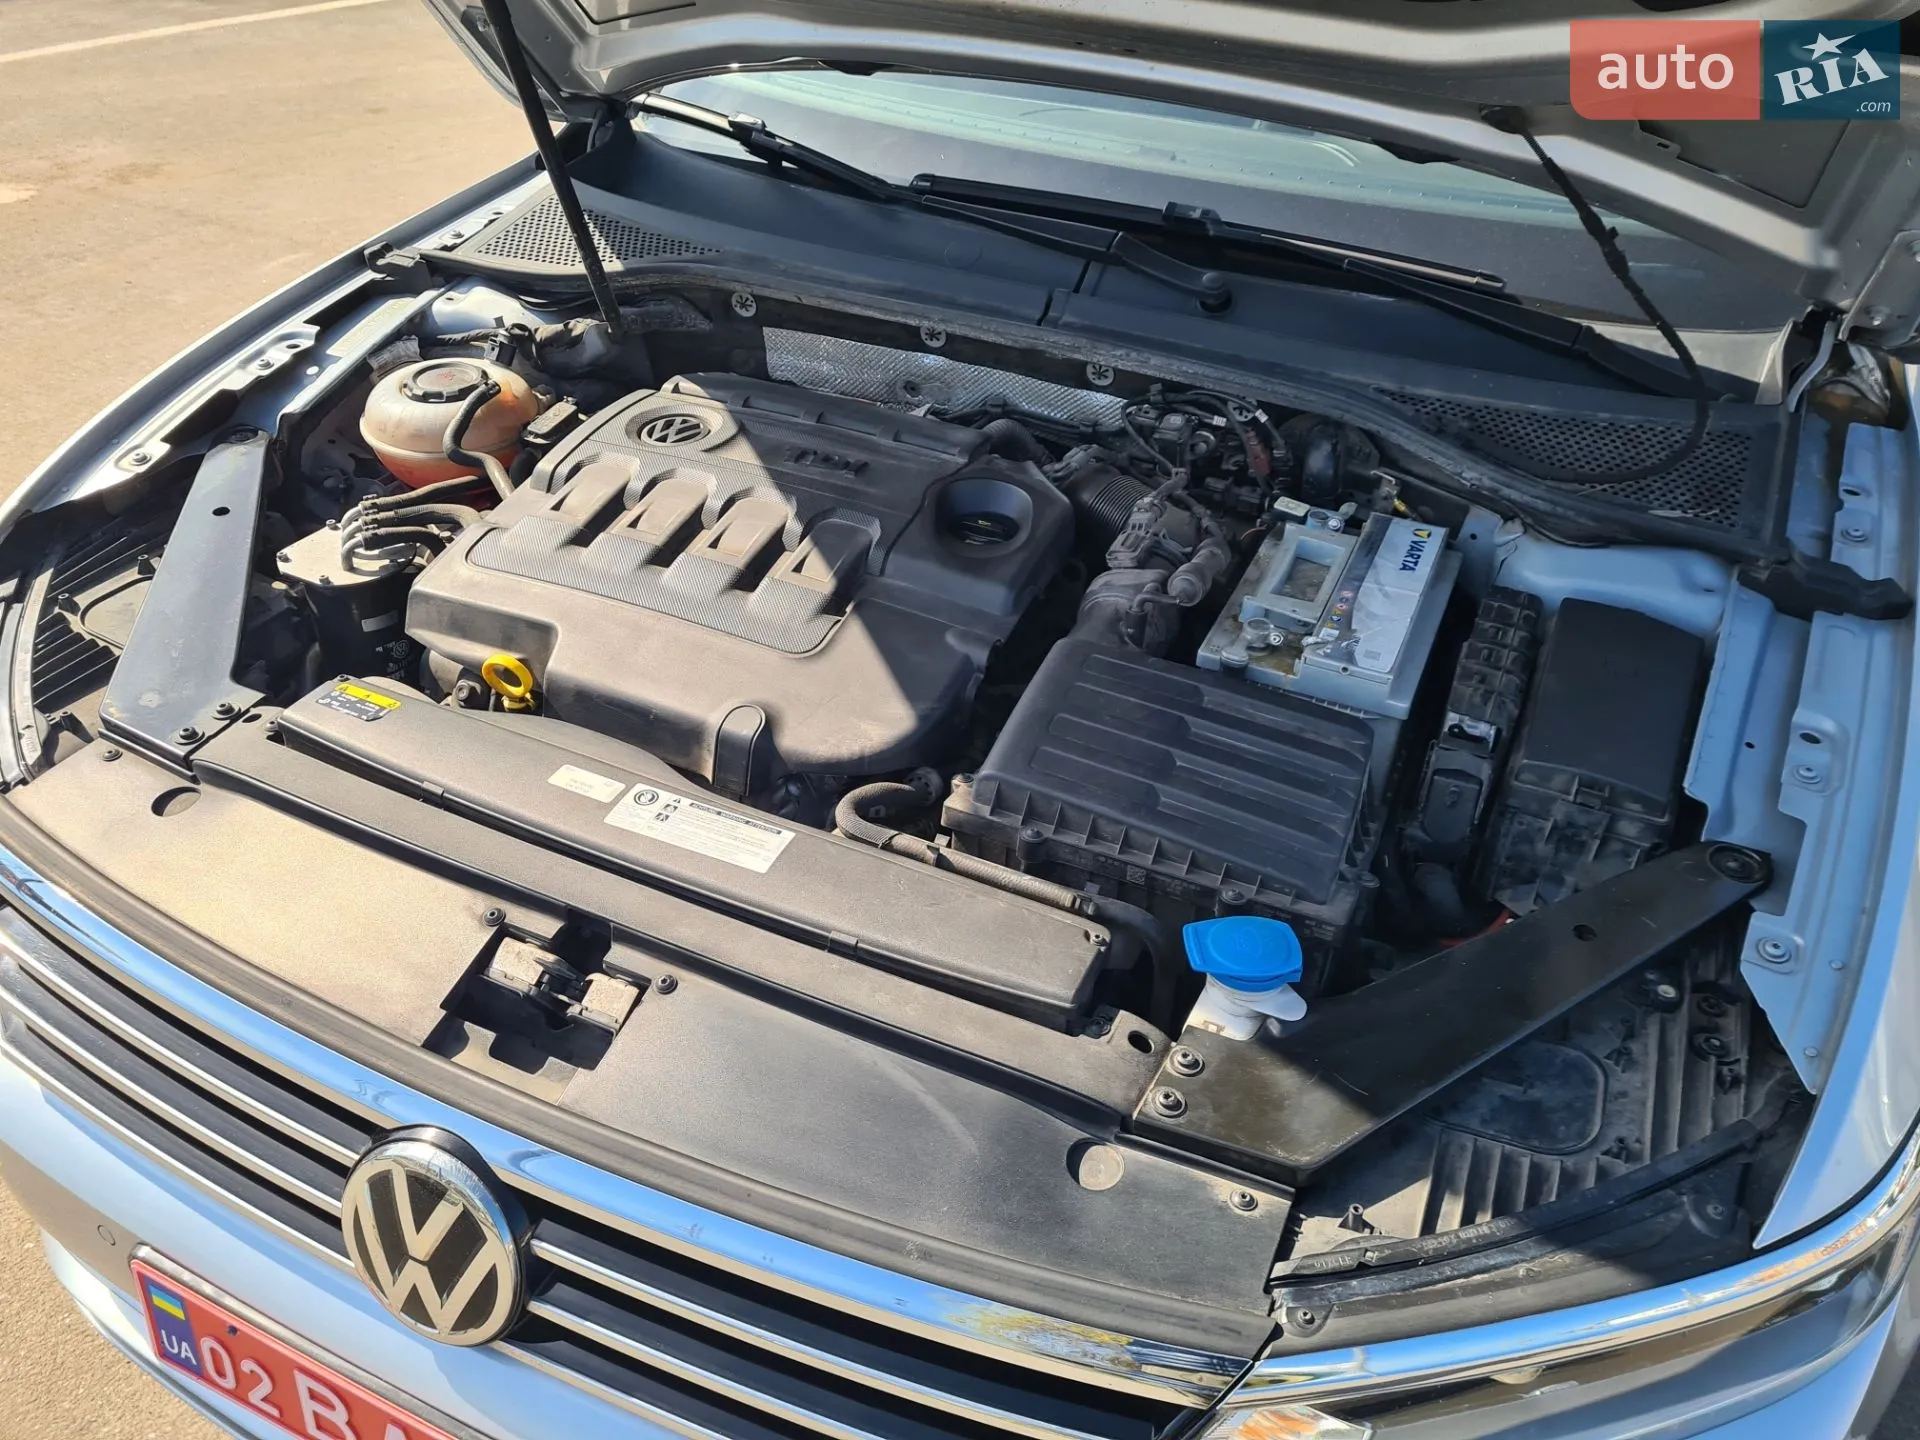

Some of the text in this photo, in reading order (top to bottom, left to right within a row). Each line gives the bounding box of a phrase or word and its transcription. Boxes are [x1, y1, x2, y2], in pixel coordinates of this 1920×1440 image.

[1399, 540, 1428, 572] VARTA
[160, 1329, 198, 1366] UA
[200, 1336, 408, 1440] 02 B
